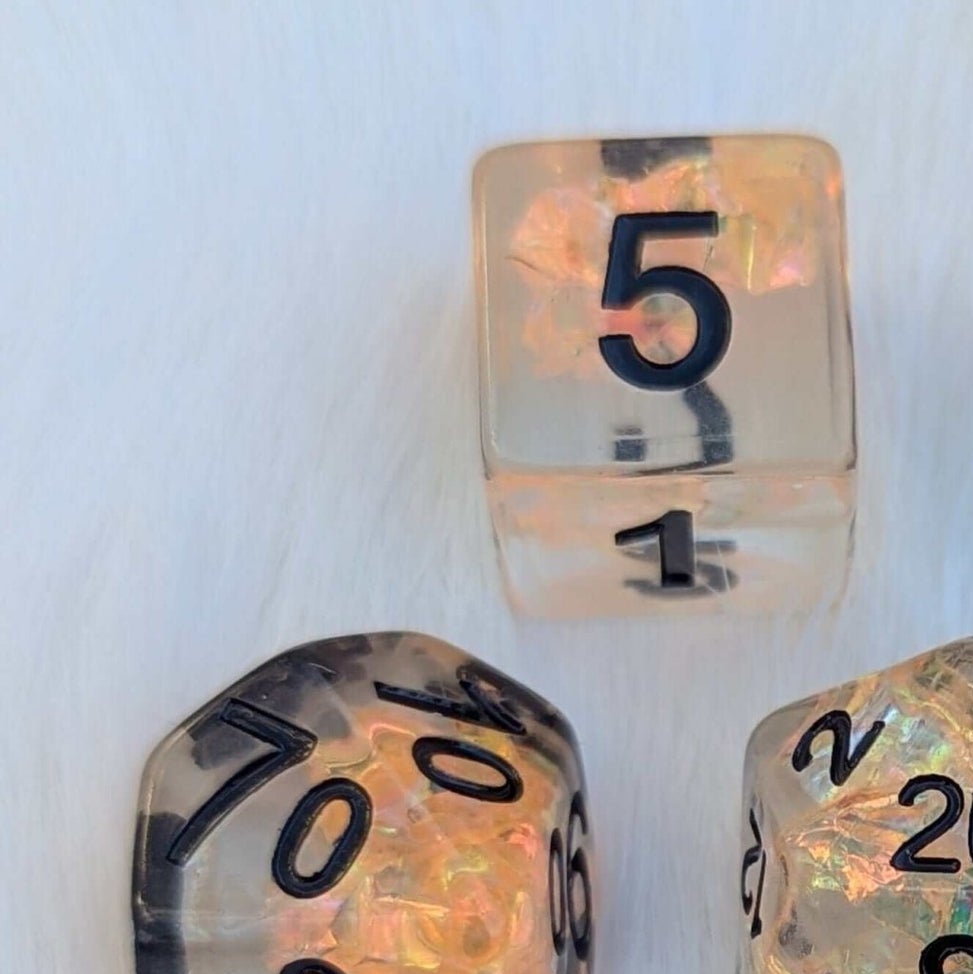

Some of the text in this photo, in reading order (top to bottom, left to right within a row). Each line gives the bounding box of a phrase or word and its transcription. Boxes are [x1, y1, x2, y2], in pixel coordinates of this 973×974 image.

[598, 210, 733, 392] 5
[614, 510, 697, 589] 1
[166, 697, 373, 899] 70
[792, 709, 886, 786] 2
